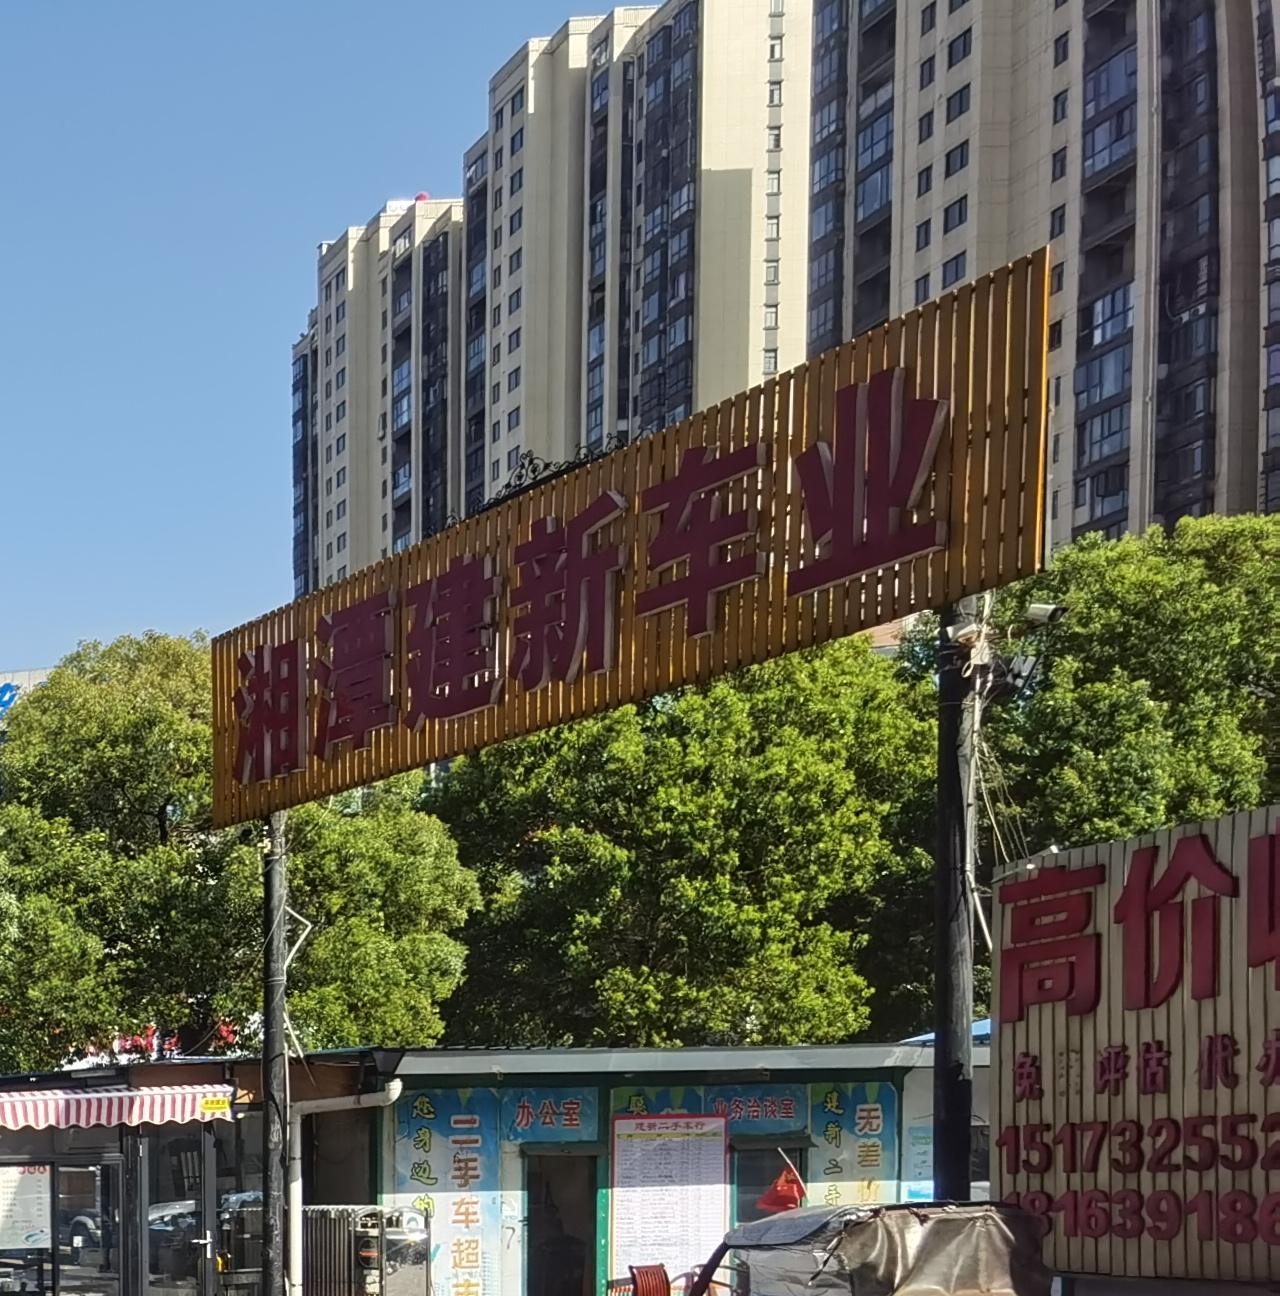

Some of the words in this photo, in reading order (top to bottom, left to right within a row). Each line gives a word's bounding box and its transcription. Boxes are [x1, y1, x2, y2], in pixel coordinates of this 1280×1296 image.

[234, 367, 949, 784] 湘潭建新车业
[1012, 1040, 1173, 1102] 免评估
[515, 1099, 582, 1129] 办公室
[713, 1097, 795, 1120] 业务洽谈室
[410, 1093, 438, 1216] 您身边的
[1005, 1190, 1280, 1246] 81639186
